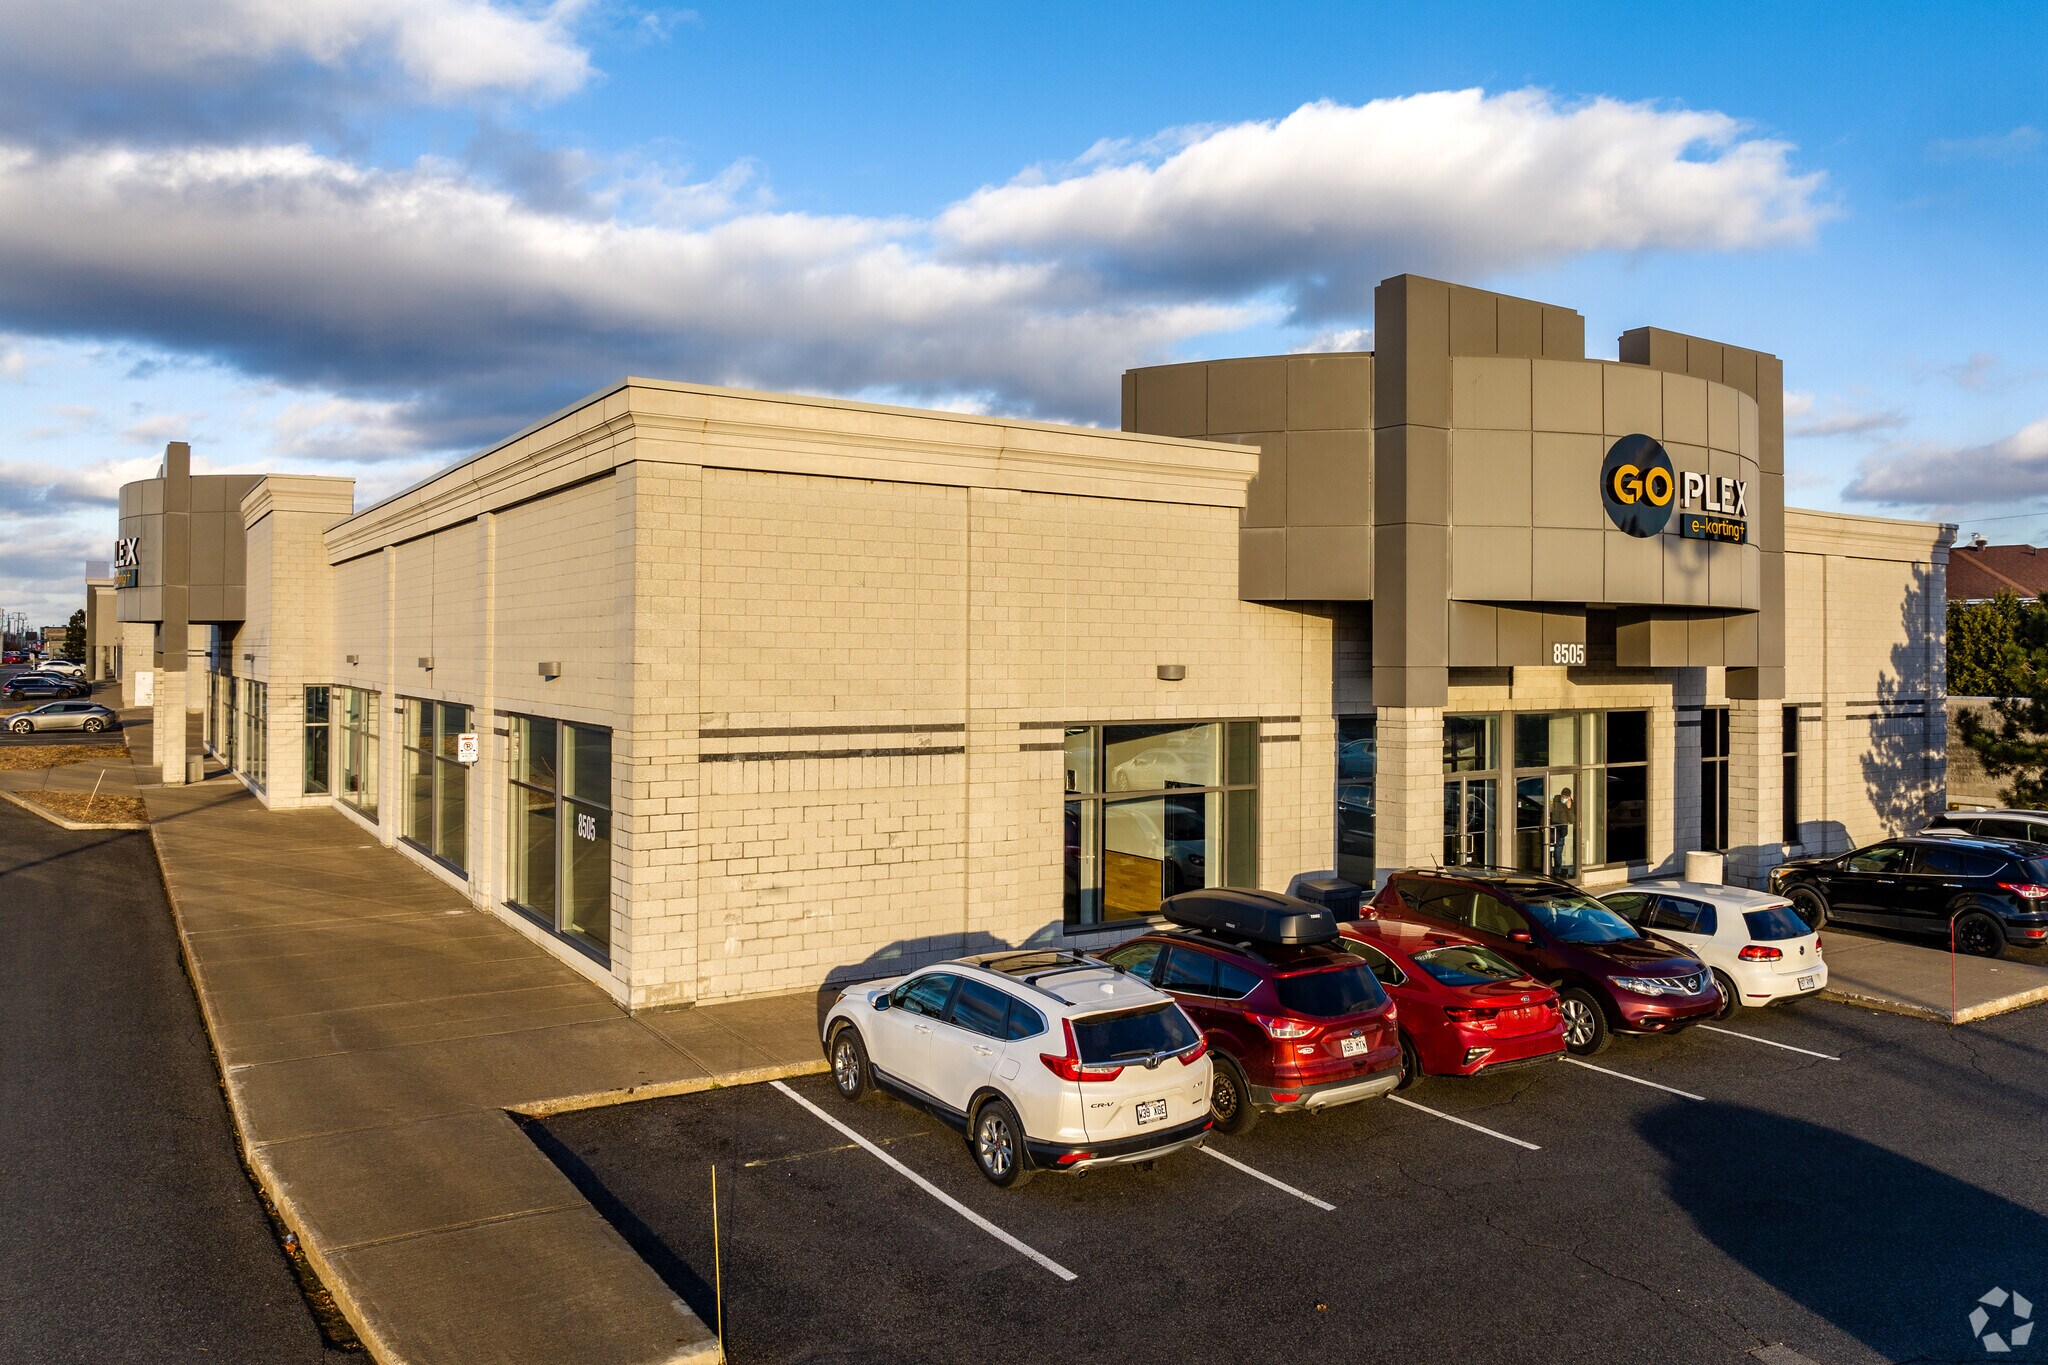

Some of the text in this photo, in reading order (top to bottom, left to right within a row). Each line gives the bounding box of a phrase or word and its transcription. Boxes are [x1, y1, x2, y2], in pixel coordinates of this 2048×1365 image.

[1612, 464, 1748, 517] GO PLEX
[1553, 643, 1584, 664] 8505
[578, 812, 596, 842] 8505
[1090, 1101, 1115, 1109] CR-V
